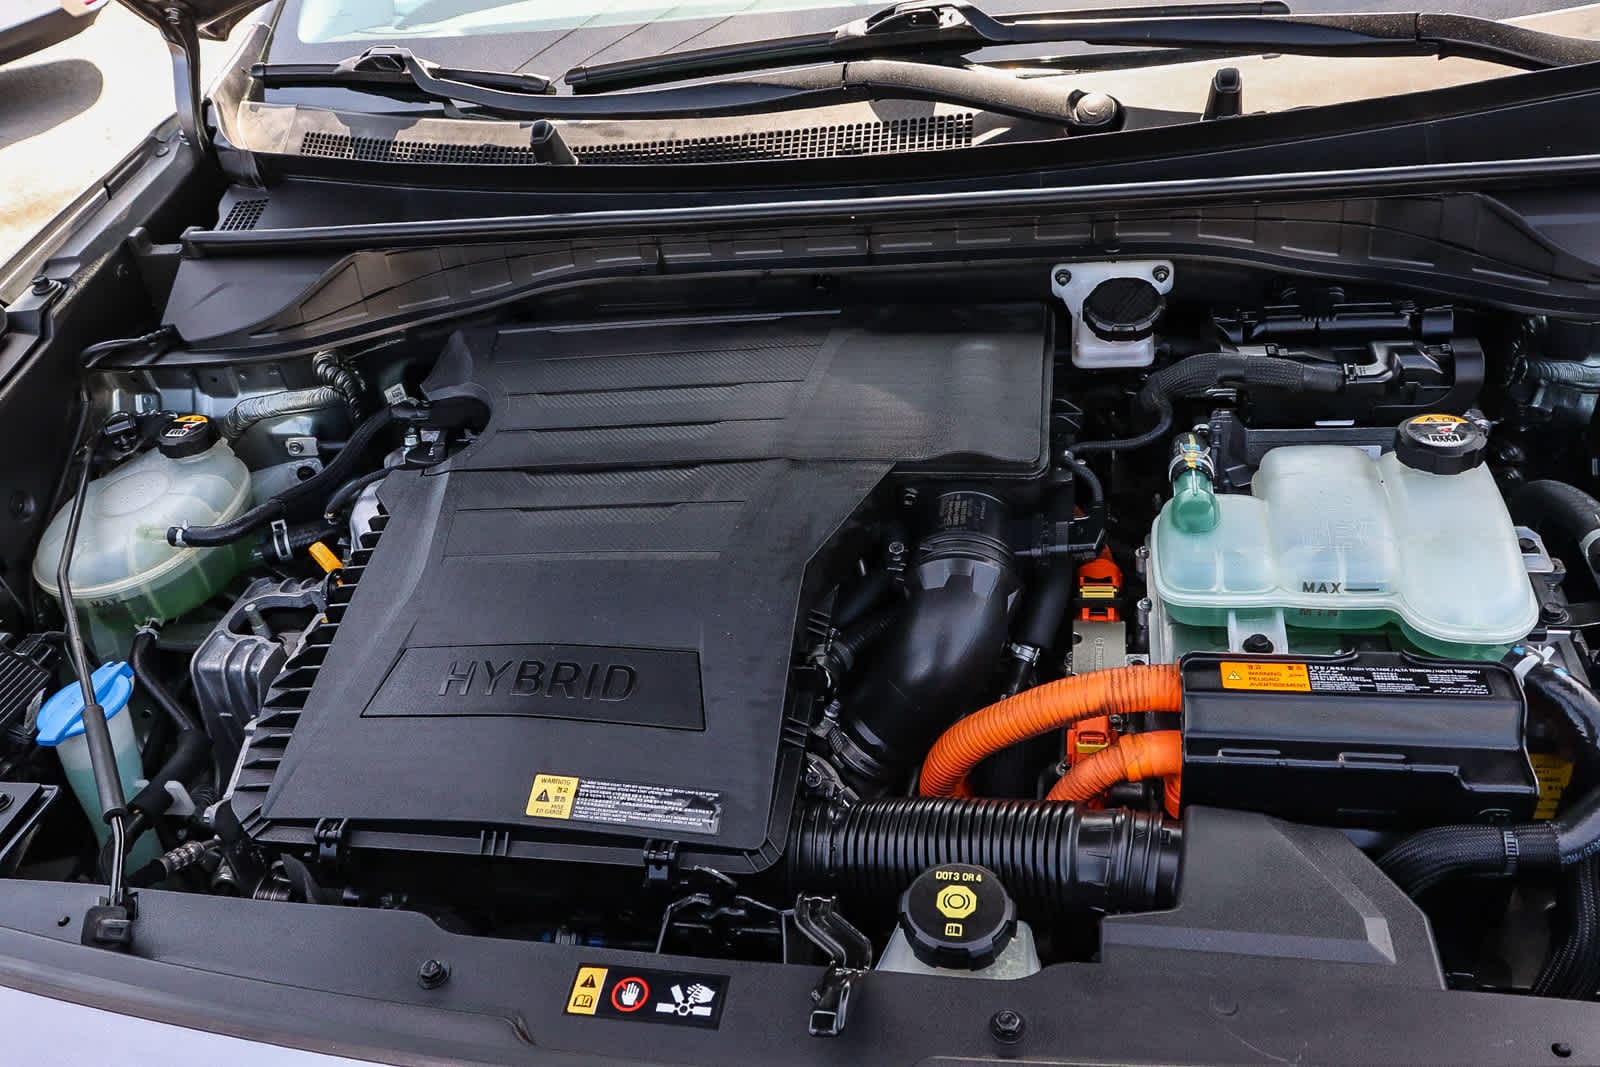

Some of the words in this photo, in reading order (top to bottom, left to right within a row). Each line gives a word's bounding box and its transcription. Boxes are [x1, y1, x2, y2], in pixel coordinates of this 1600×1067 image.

[1302, 581, 1341, 594] MAX
[438, 659, 637, 702] HYBRID
[541, 777, 572, 786] WARNING
[962, 872, 975, 882] OR
